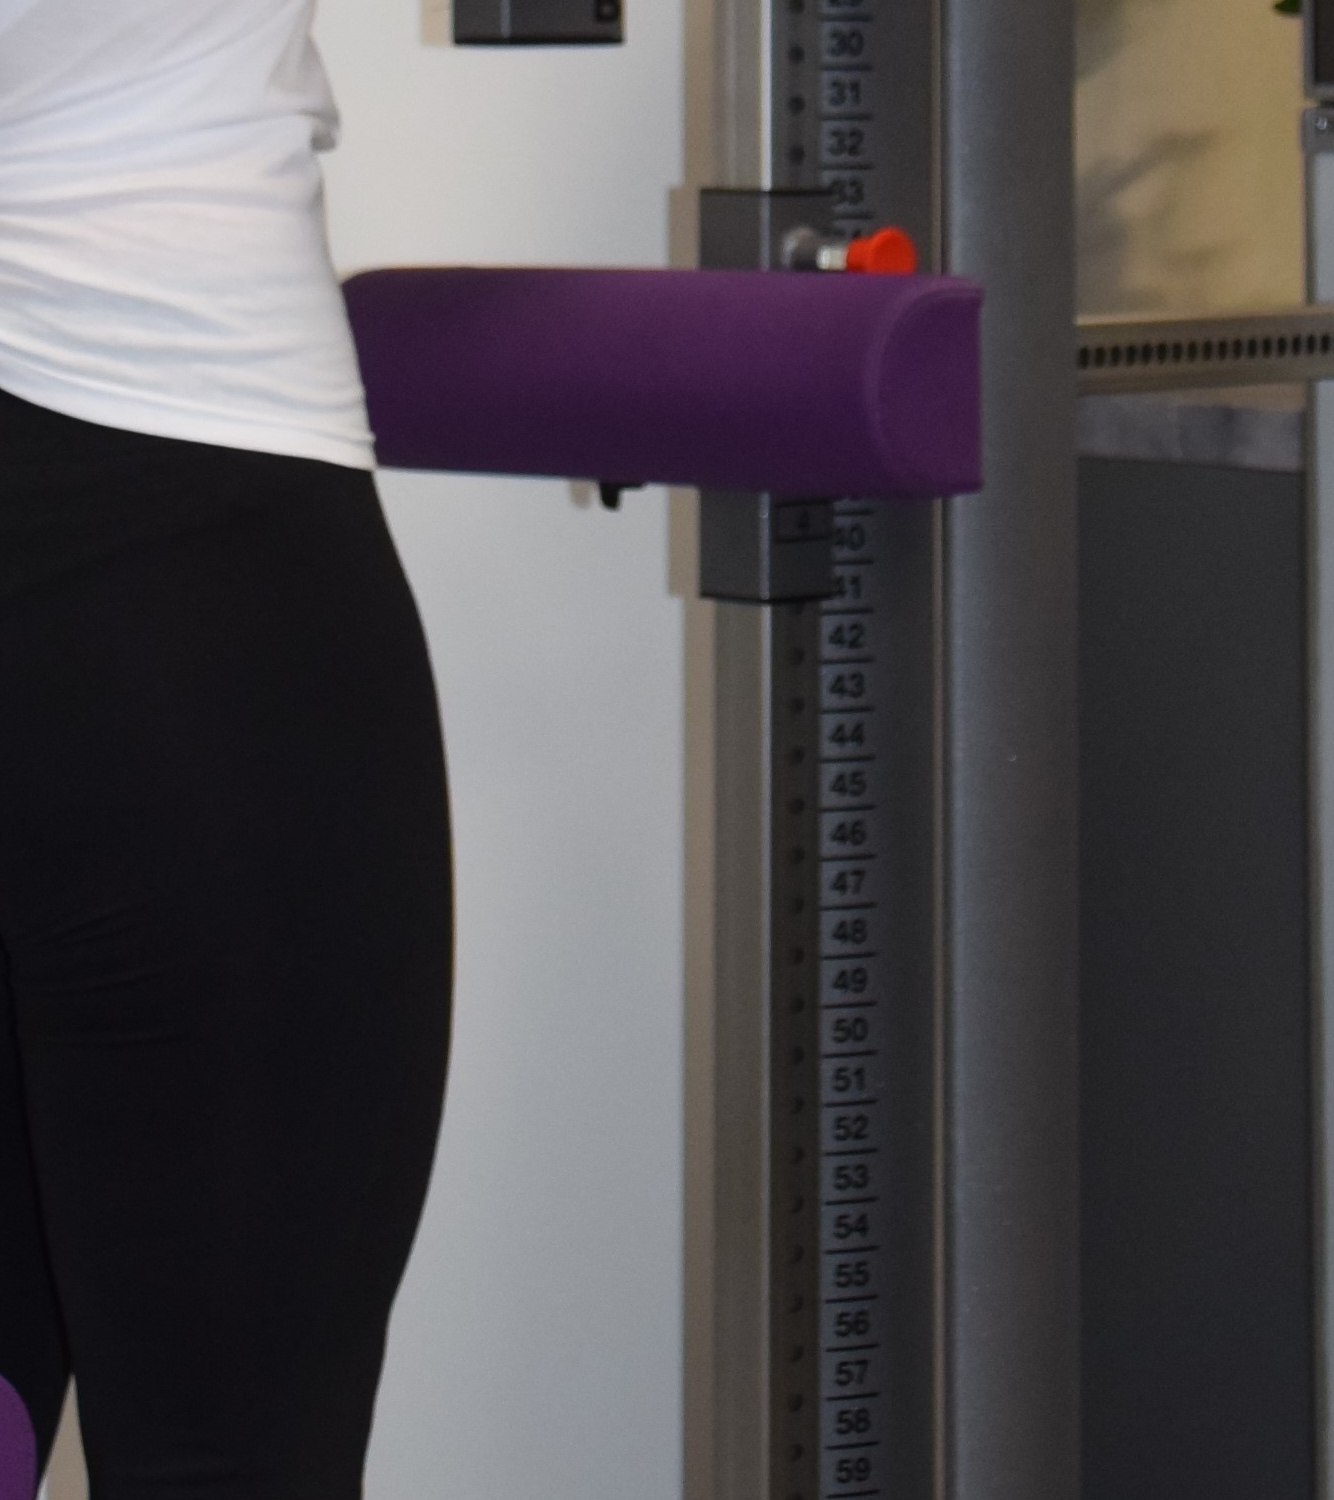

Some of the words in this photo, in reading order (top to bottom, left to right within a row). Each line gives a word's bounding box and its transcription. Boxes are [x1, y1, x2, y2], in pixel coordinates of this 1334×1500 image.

[827, 31, 862, 56] 30
[827, 80, 862, 105] 31
[827, 129, 862, 154] 32
[828, 624, 864, 648] 42
[829, 673, 864, 697] 43
[829, 722, 865, 746] 44
[829, 772, 865, 796] 45
[830, 821, 865, 845] 46
[831, 870, 866, 894] 47
[831, 920, 866, 944] 48
[831, 969, 867, 993] 49
[832, 1018, 867, 1042] 50
[833, 1067, 866, 1092] 51
[833, 1116, 866, 1141] 52
[833, 1165, 866, 1190] 53
[834, 1214, 867, 1239] 54
[834, 1263, 867, 1288] 55
[834, 1312, 867, 1336] 56
[834, 1360, 867, 1385] 57
[834, 1409, 867, 1434] 58
[835, 1458, 868, 1483] 59
